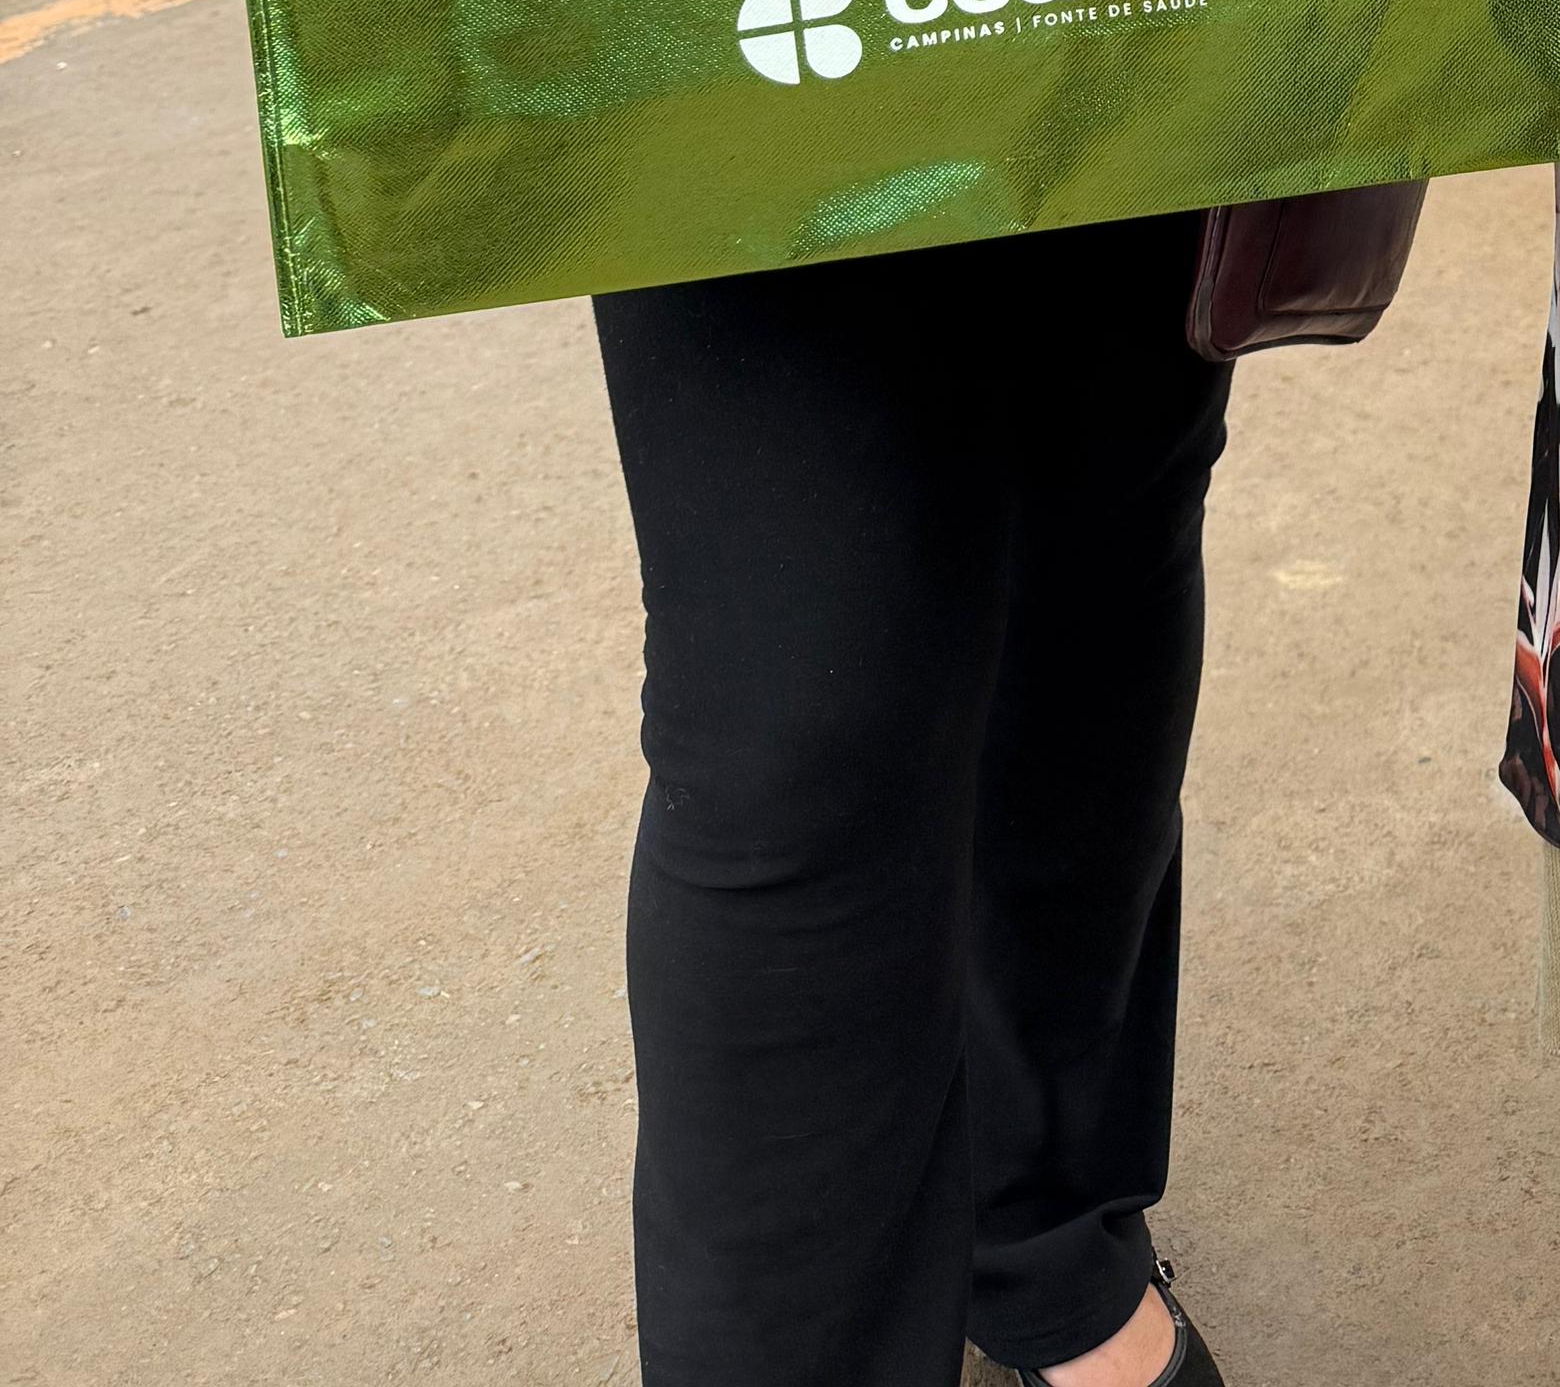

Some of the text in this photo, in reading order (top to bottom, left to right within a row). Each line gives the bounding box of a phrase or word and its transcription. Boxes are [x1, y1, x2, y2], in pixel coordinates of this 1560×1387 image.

[889, 22, 1006, 52] CAMPINAS
[1032, 9, 1099, 28] FONTE
[1108, 2, 1133, 17] DE
